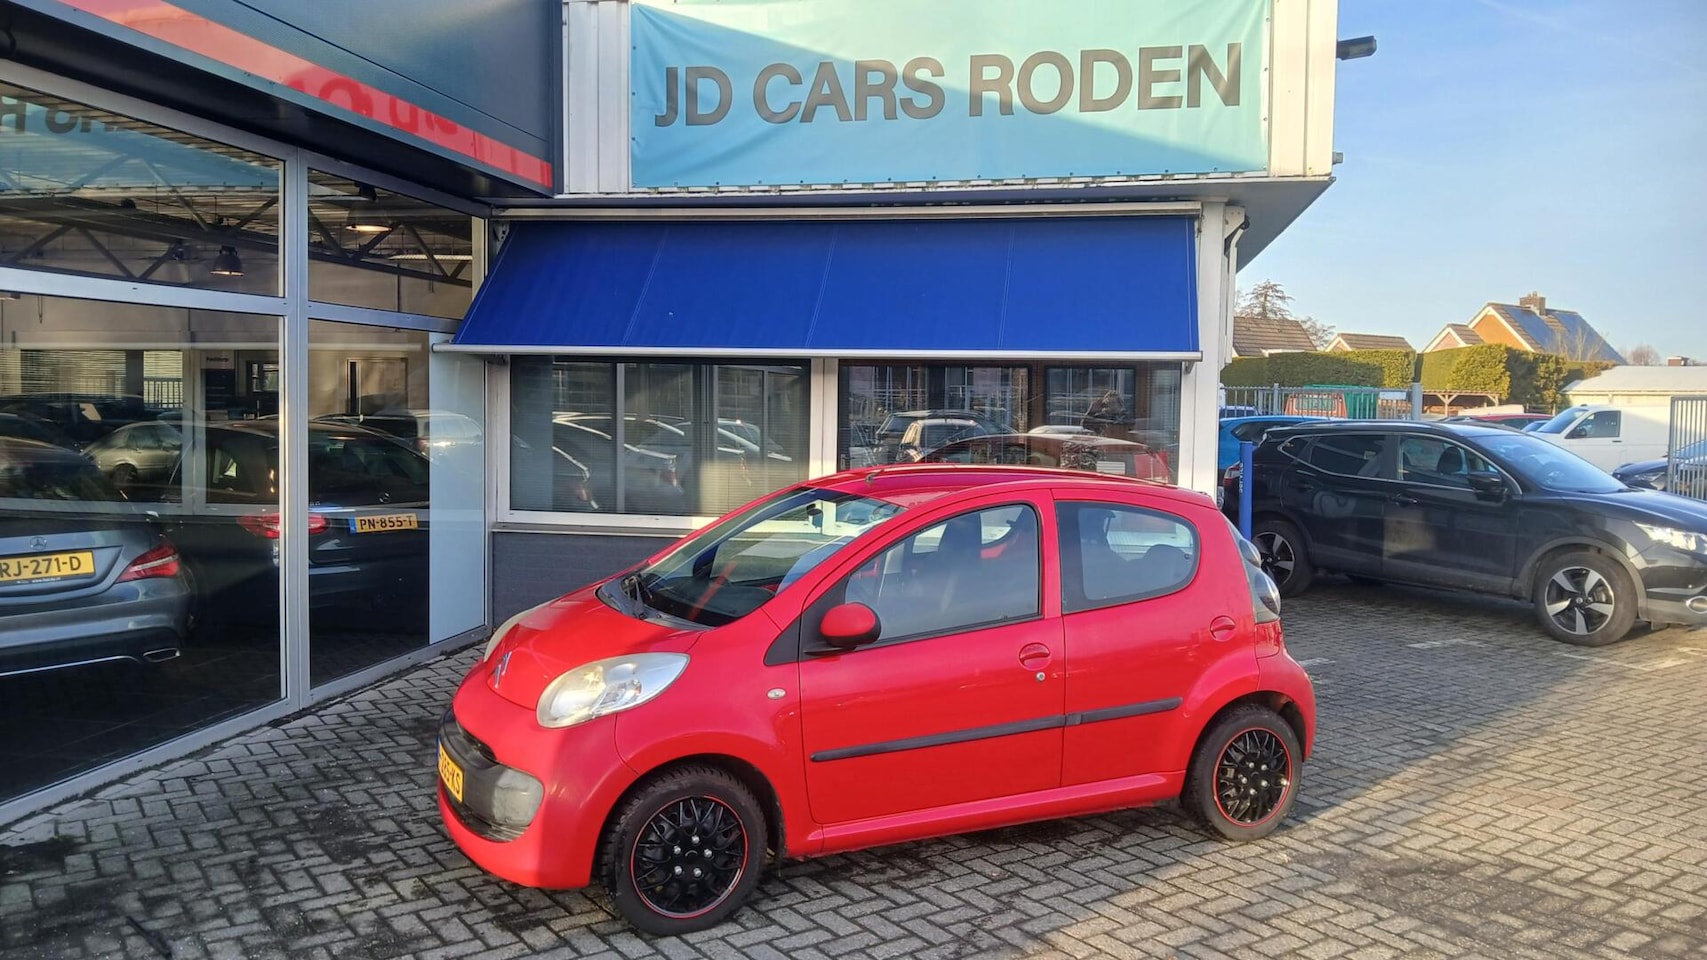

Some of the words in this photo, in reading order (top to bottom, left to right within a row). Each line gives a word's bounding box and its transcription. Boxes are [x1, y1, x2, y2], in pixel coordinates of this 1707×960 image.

[655, 66, 733, 127] JD
[753, 57, 946, 124] CARS
[969, 43, 1242, 117] RODEN
[360, 515, 413, 530] PN-855-T
[0, 556, 82, 578] RJ-271-D
